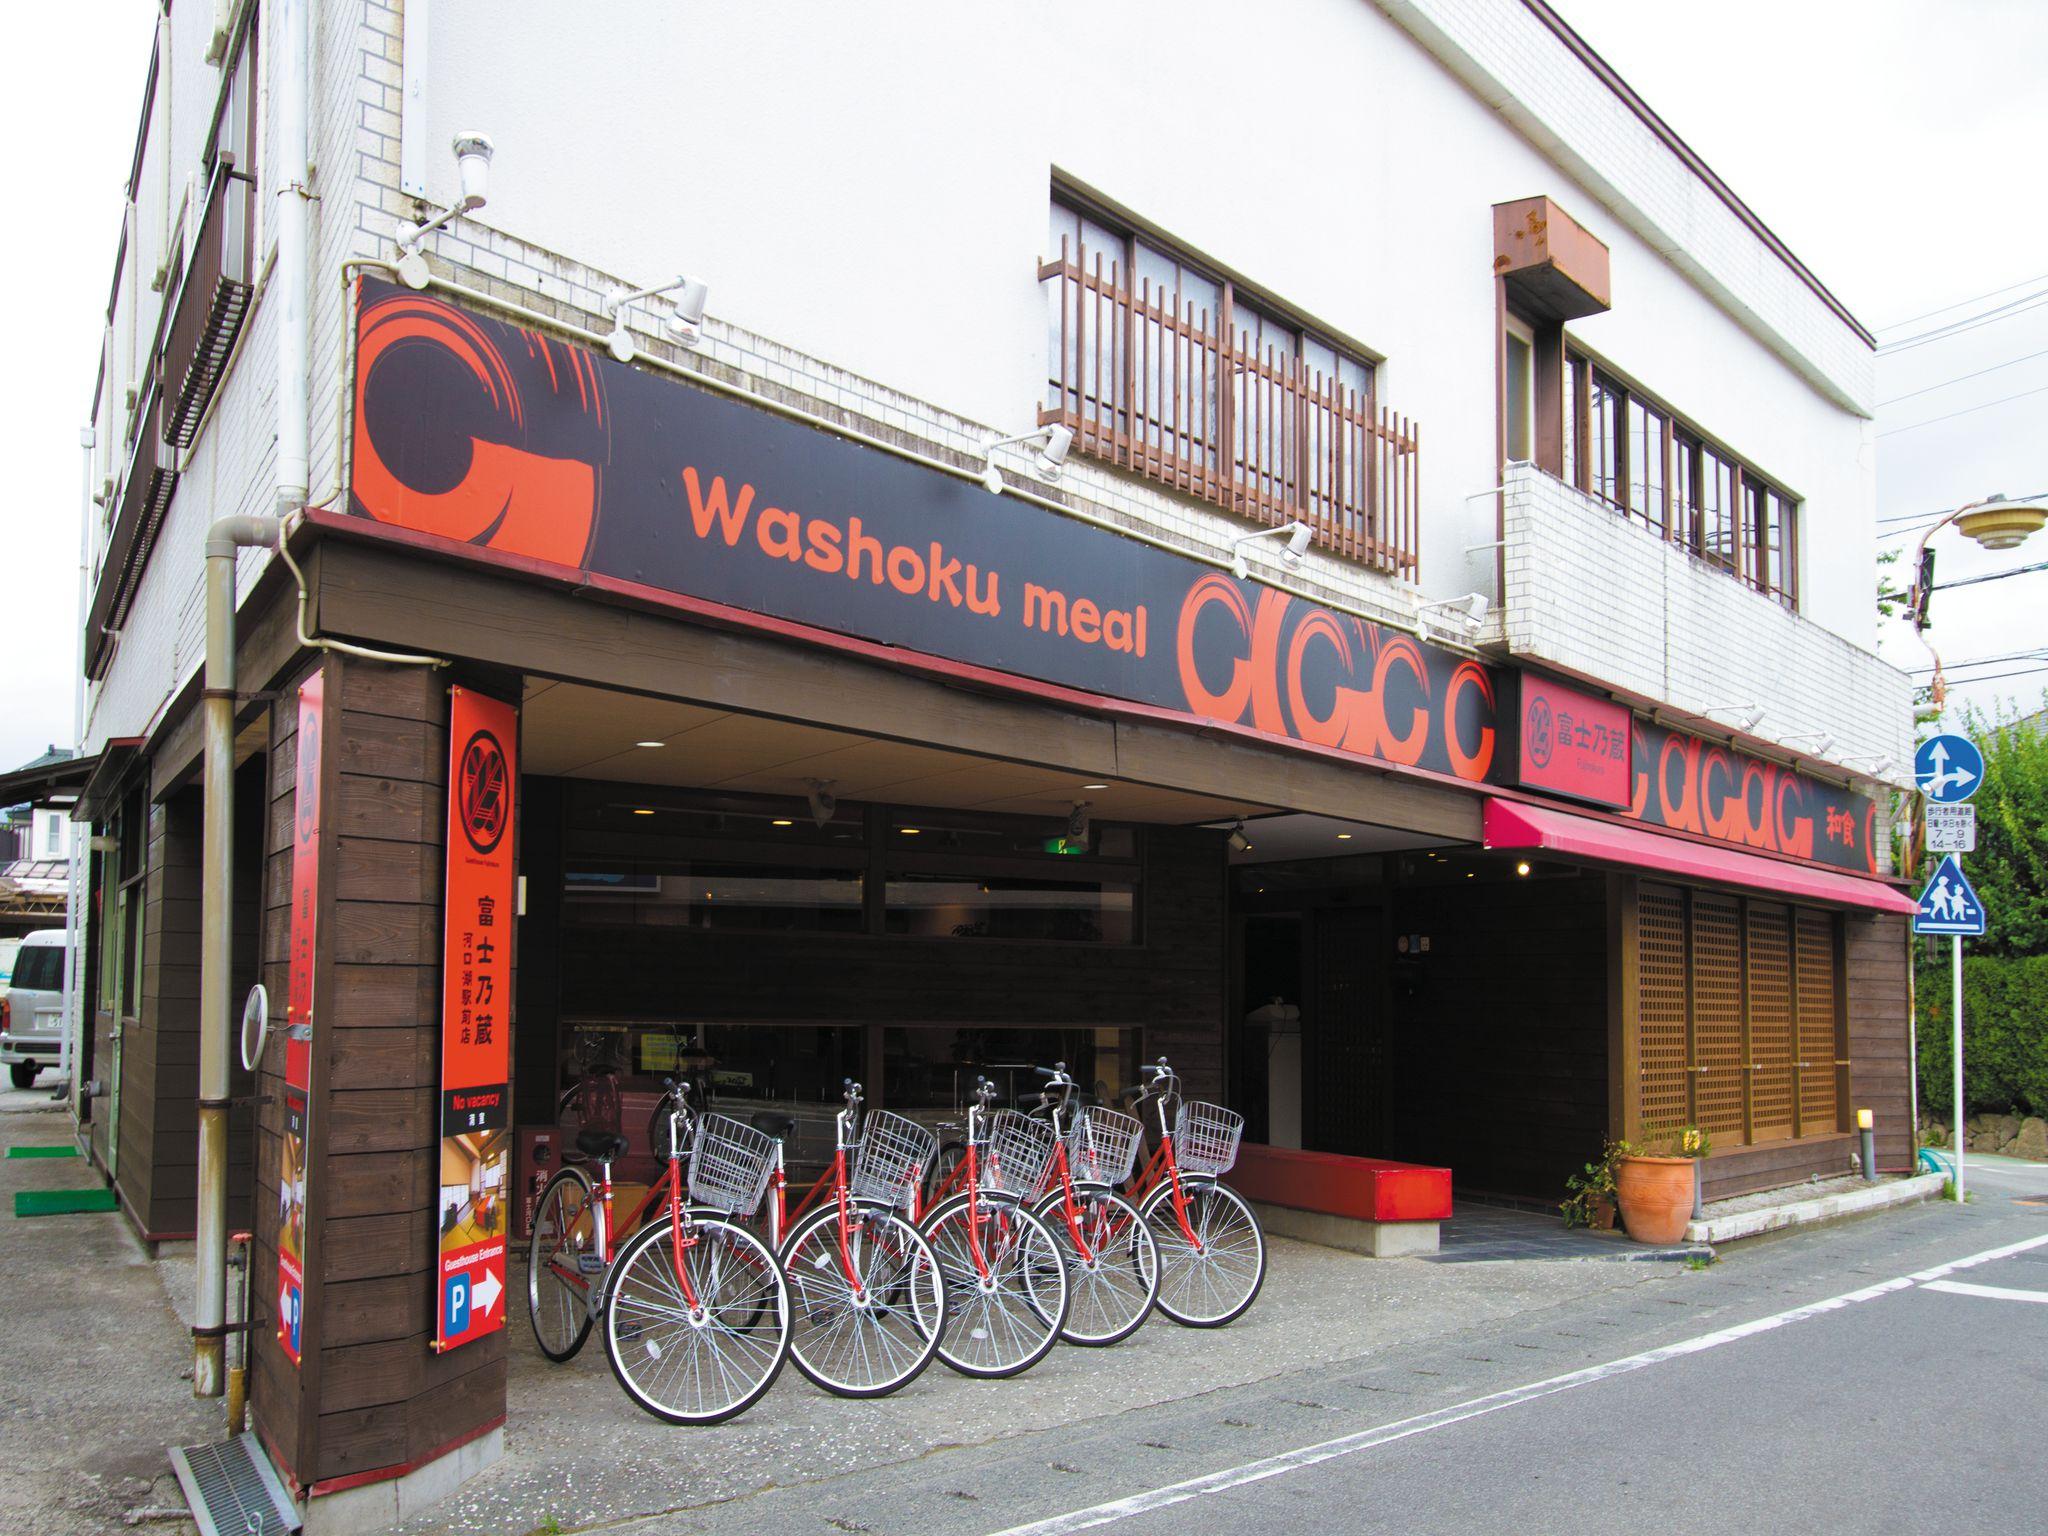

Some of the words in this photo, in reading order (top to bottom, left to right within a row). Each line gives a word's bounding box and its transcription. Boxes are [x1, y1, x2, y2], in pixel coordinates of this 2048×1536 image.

[682, 466, 1001, 617] Washoku
[1023, 582, 1147, 658] meal
[1557, 712, 1625, 761] 富士乃蔵
[1826, 806, 1855, 848] 和食
[461, 932, 473, 1044] 河口湖駅前店
[474, 895, 495, 1045] 富士乃蔵
[453, 1094, 465, 1111] No
[467, 1092, 500, 1108] vacancy
[445, 1254, 479, 1271] Guesthouse
[479, 1245, 503, 1261] Entrance
[452, 1284, 465, 1323] P
